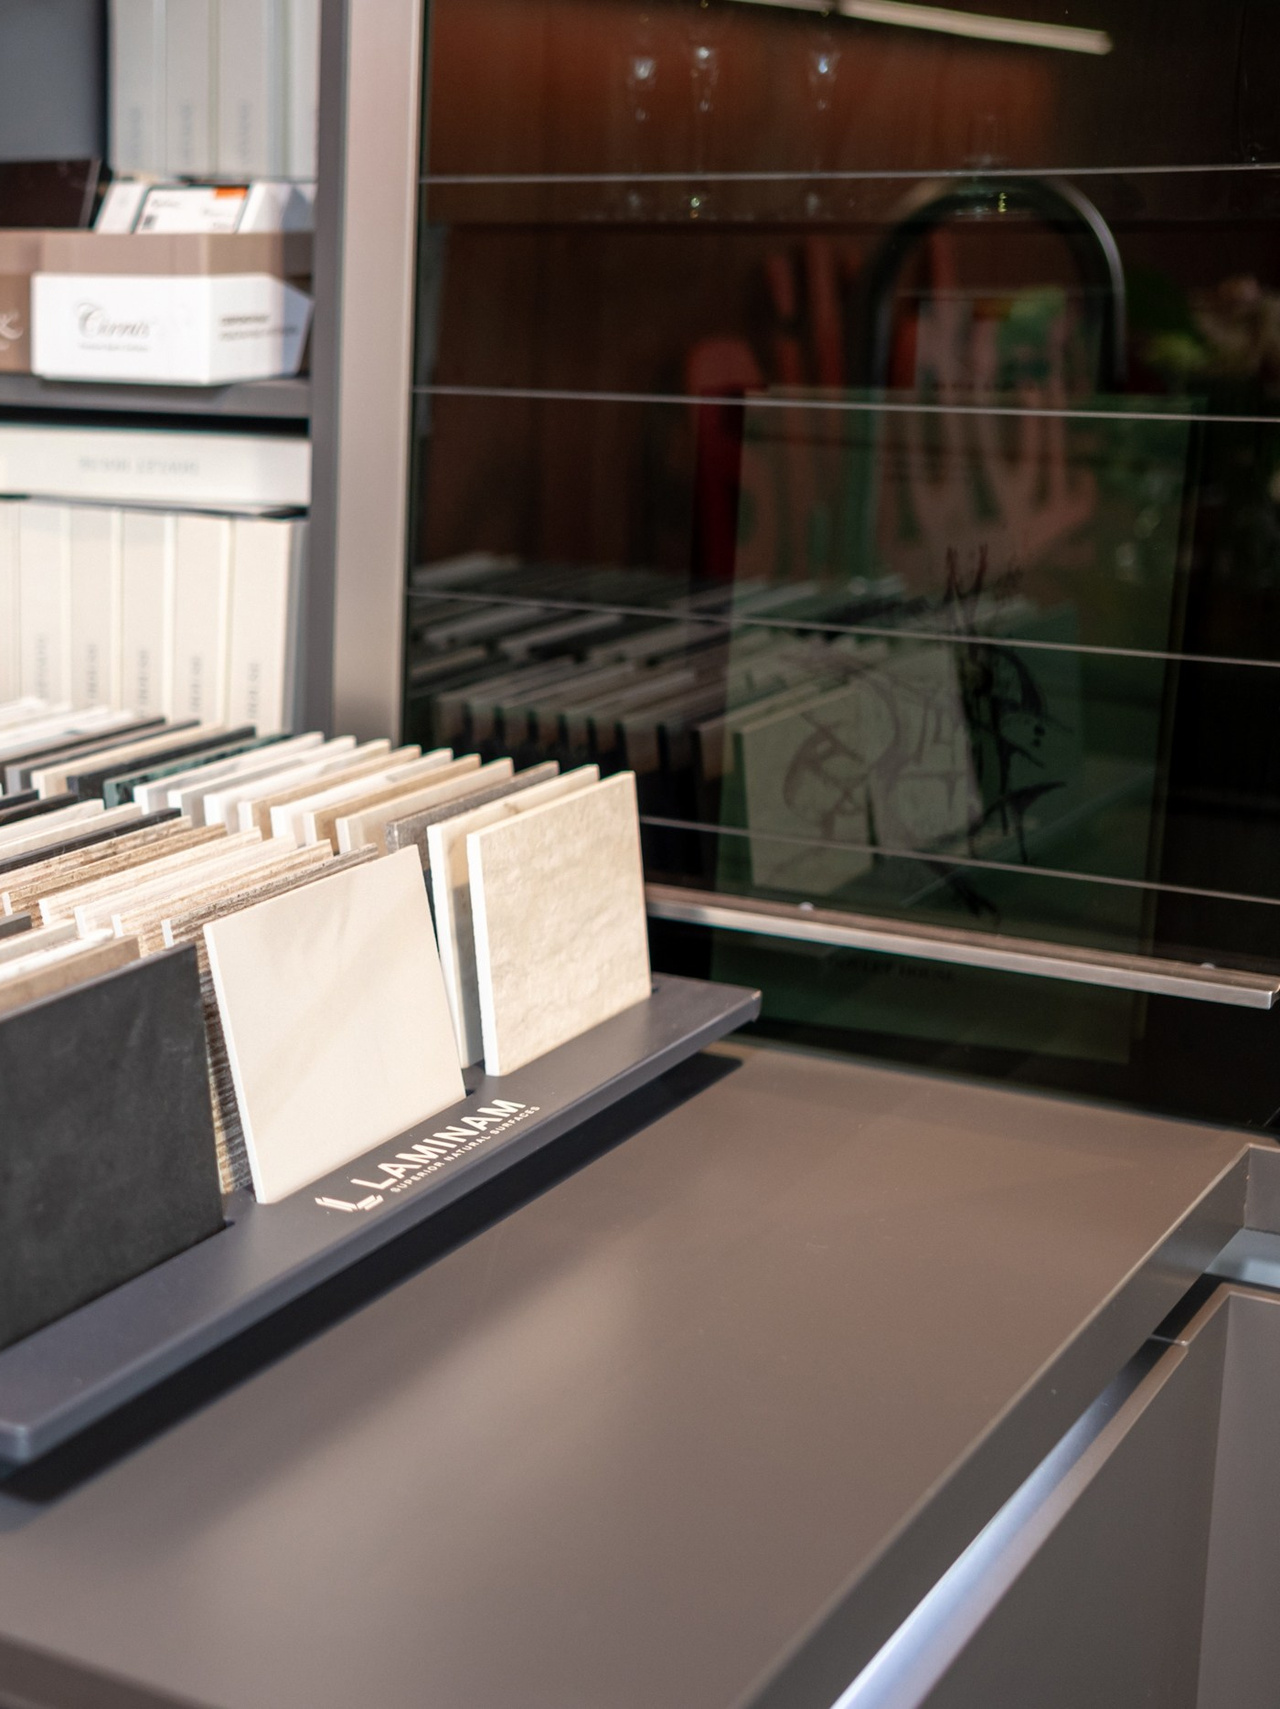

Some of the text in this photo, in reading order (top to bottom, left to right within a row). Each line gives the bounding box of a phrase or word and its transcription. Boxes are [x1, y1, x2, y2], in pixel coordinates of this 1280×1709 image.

[350, 1098, 527, 1190] LAMINAM
[390, 1106, 541, 1193] SUPERIOR NATURAL SURFACES
